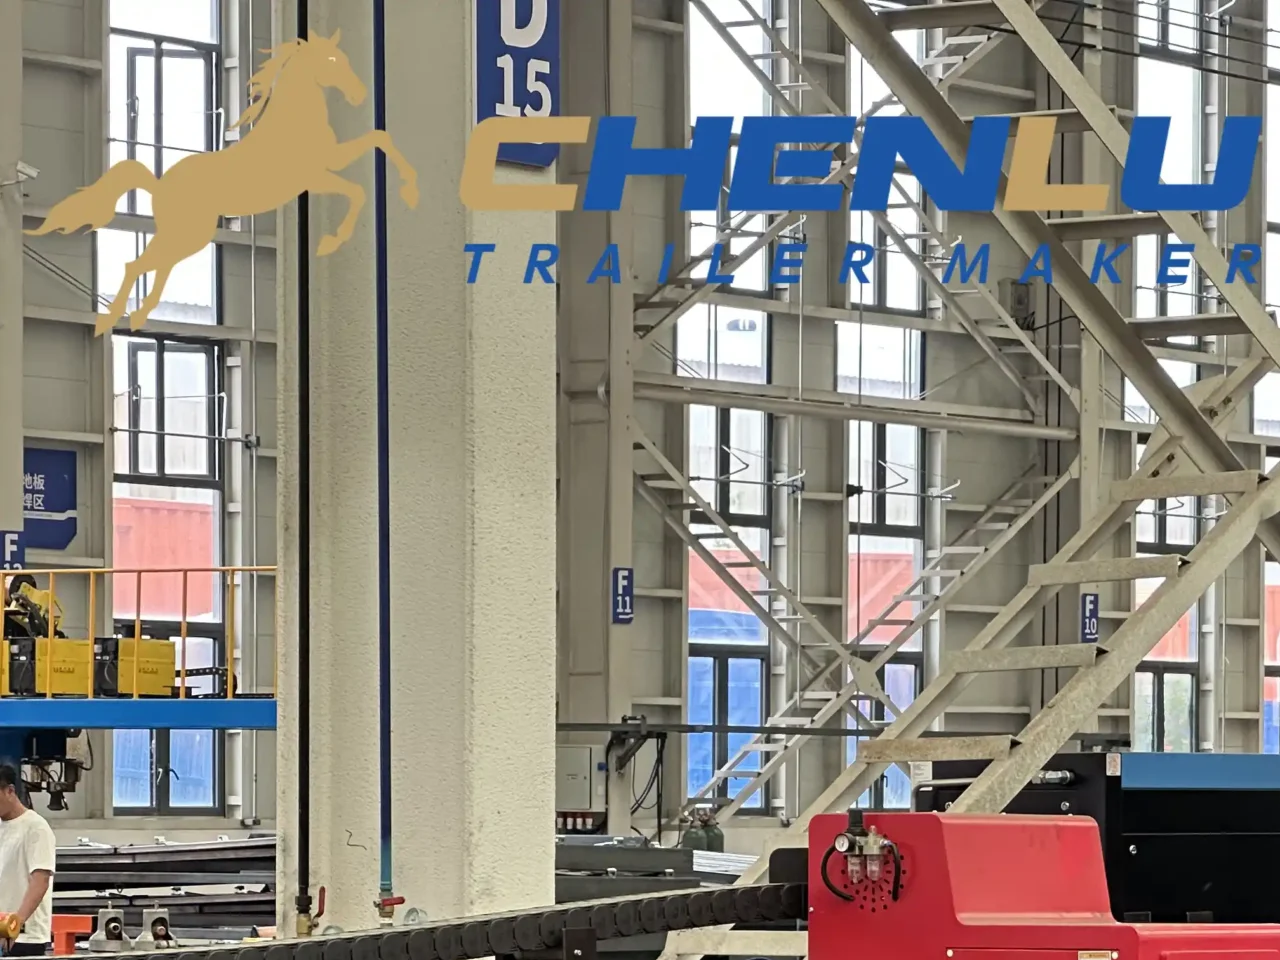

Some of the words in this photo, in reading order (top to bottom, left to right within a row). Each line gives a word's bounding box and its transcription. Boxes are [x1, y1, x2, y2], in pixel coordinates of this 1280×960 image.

[495, 53, 552, 118] 15
[4, 533, 19, 561] F
[618, 570, 629, 595] F
[616, 596, 632, 613] 11
[1085, 595, 1095, 617] F
[1084, 618, 1097, 634] 10
